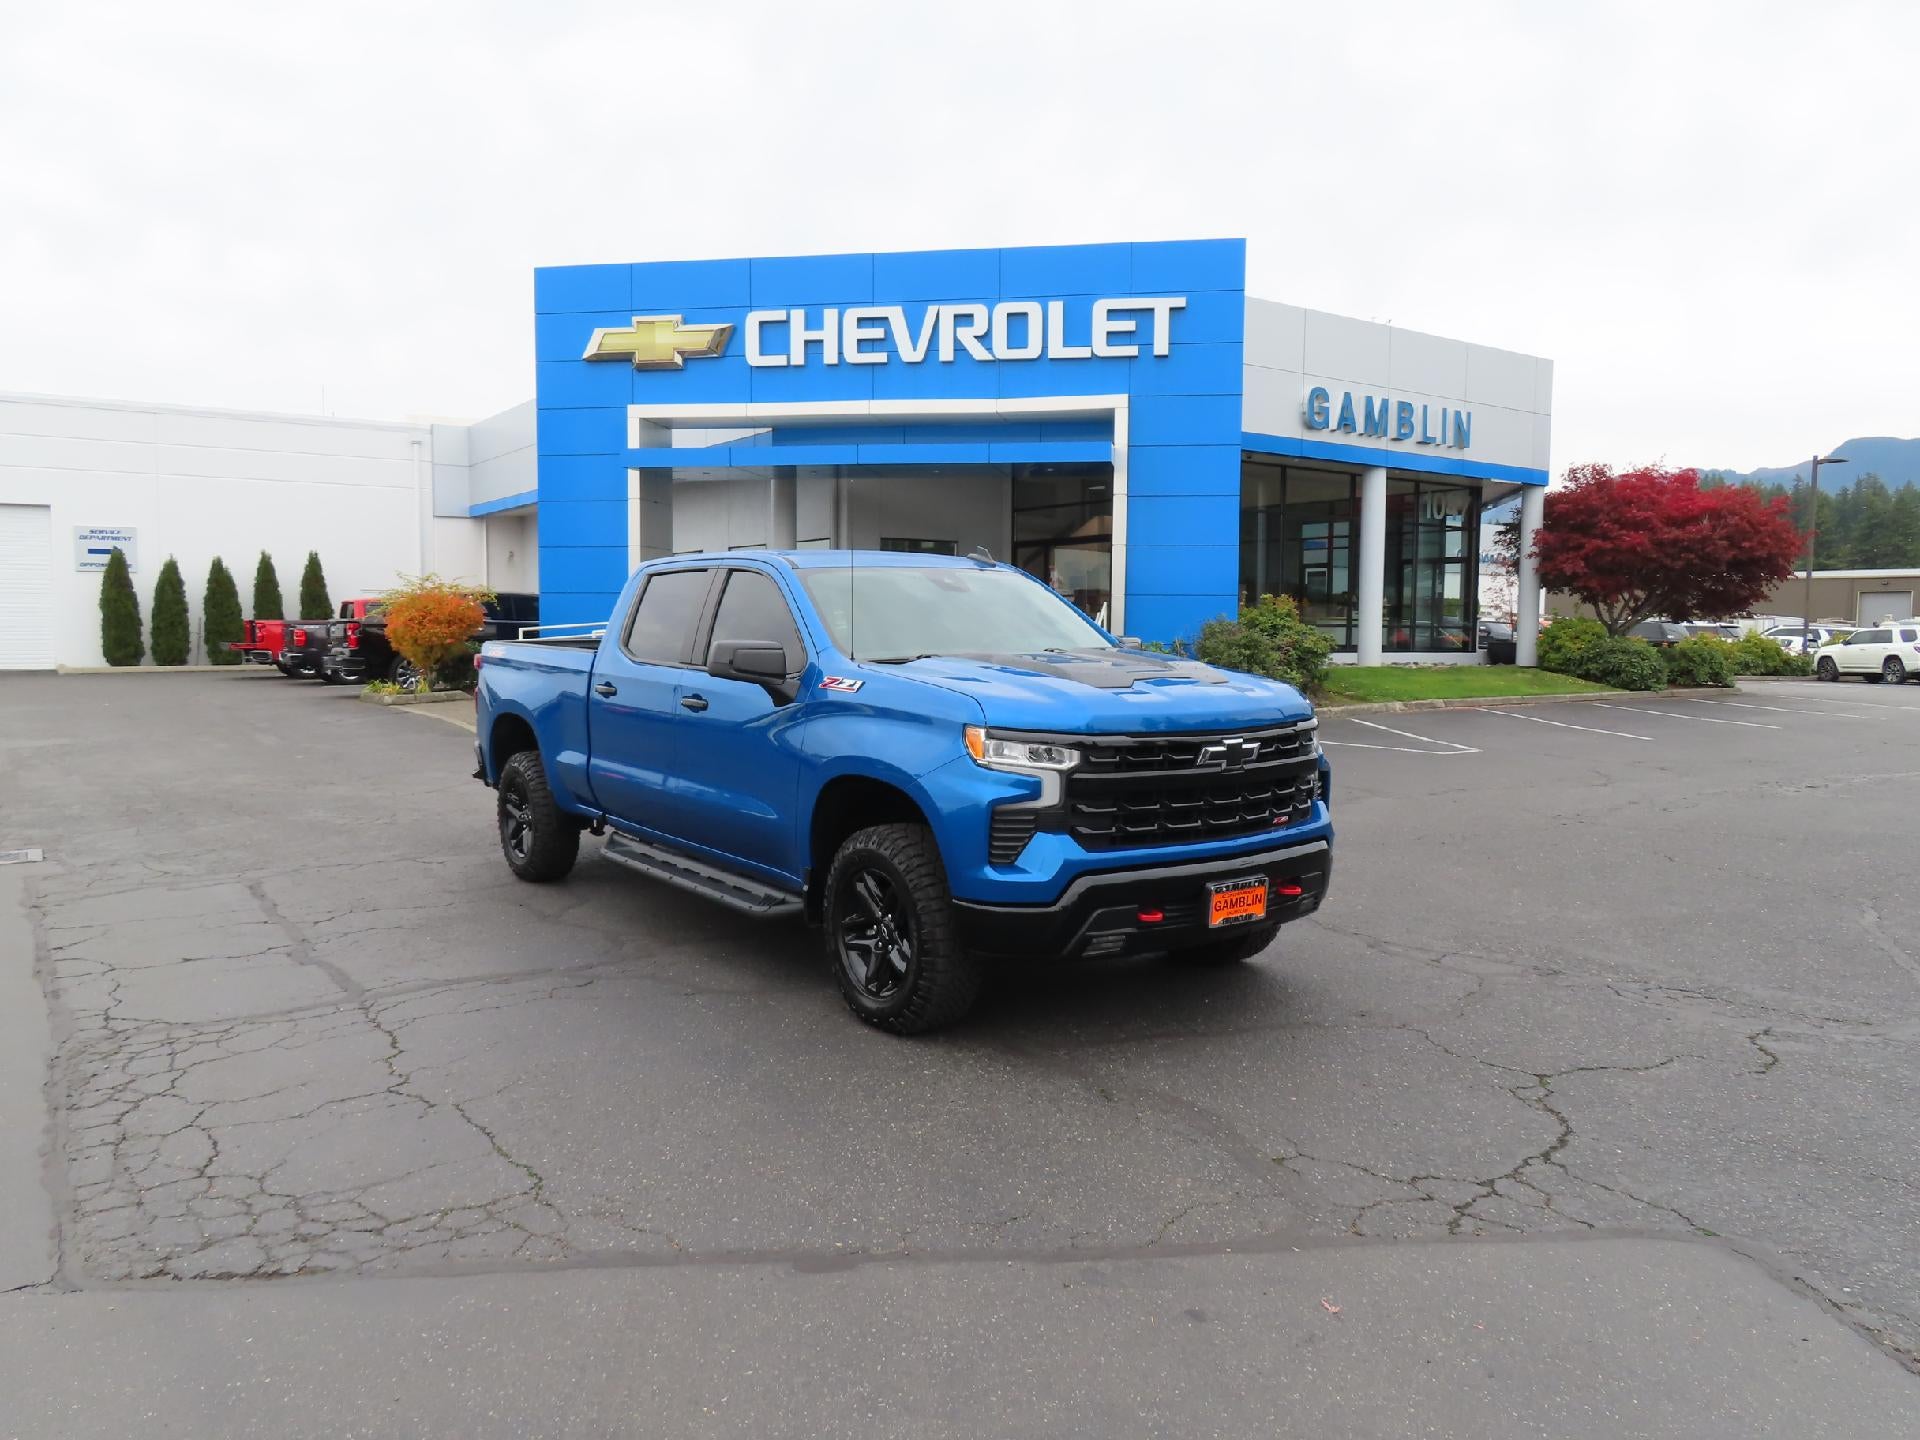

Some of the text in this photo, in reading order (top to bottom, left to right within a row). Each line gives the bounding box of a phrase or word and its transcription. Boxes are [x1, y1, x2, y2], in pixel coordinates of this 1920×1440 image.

[745, 296, 1187, 367] CHEVROLET
[1305, 386, 1472, 449] GAMBLIN
[1214, 893, 1263, 912] GAMBLIN
